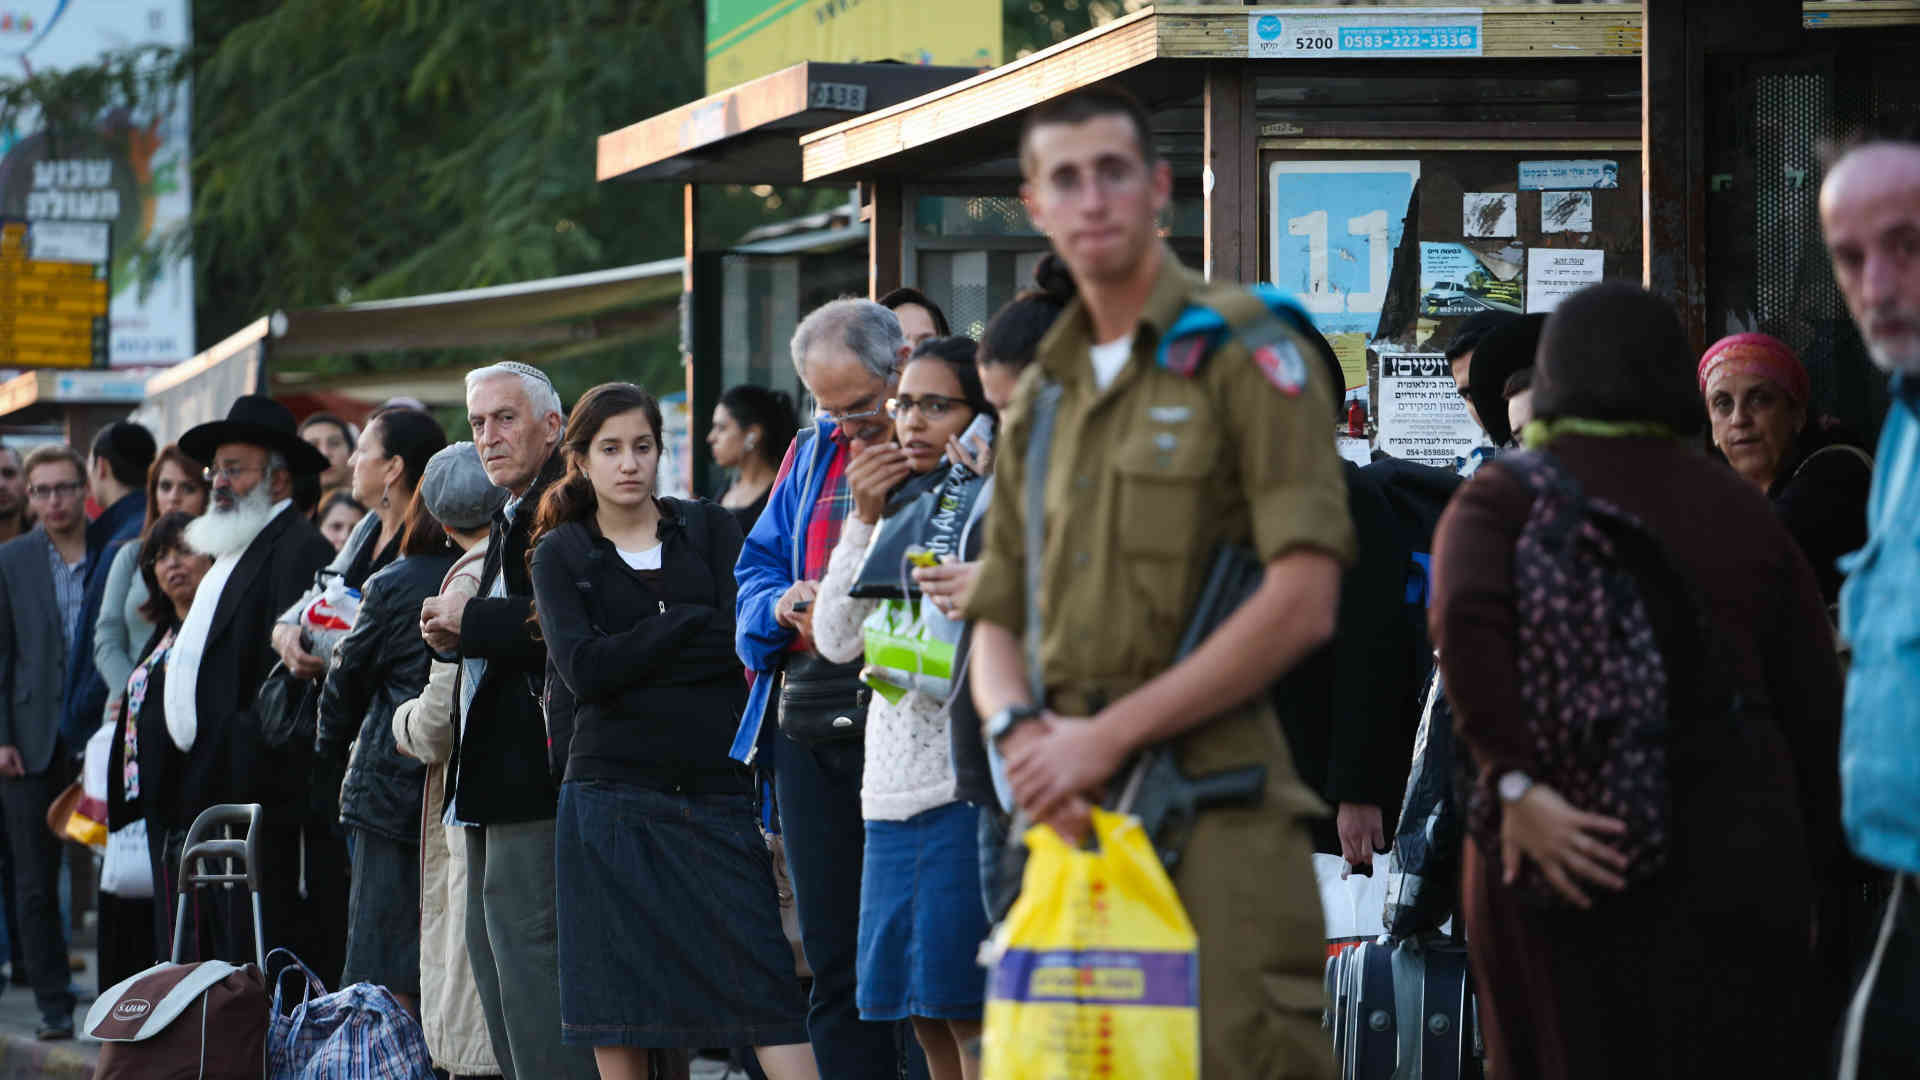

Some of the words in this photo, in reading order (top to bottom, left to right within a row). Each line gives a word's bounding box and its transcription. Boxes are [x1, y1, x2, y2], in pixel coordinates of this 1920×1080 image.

[1296, 37, 1333, 49] 5200
[1391, 358, 1448, 376] ושים!
[1397, 380, 1437, 389] בינלאומית
[1439, 381, 1457, 389] ברה
[1398, 402, 1437, 412] תפקידים
